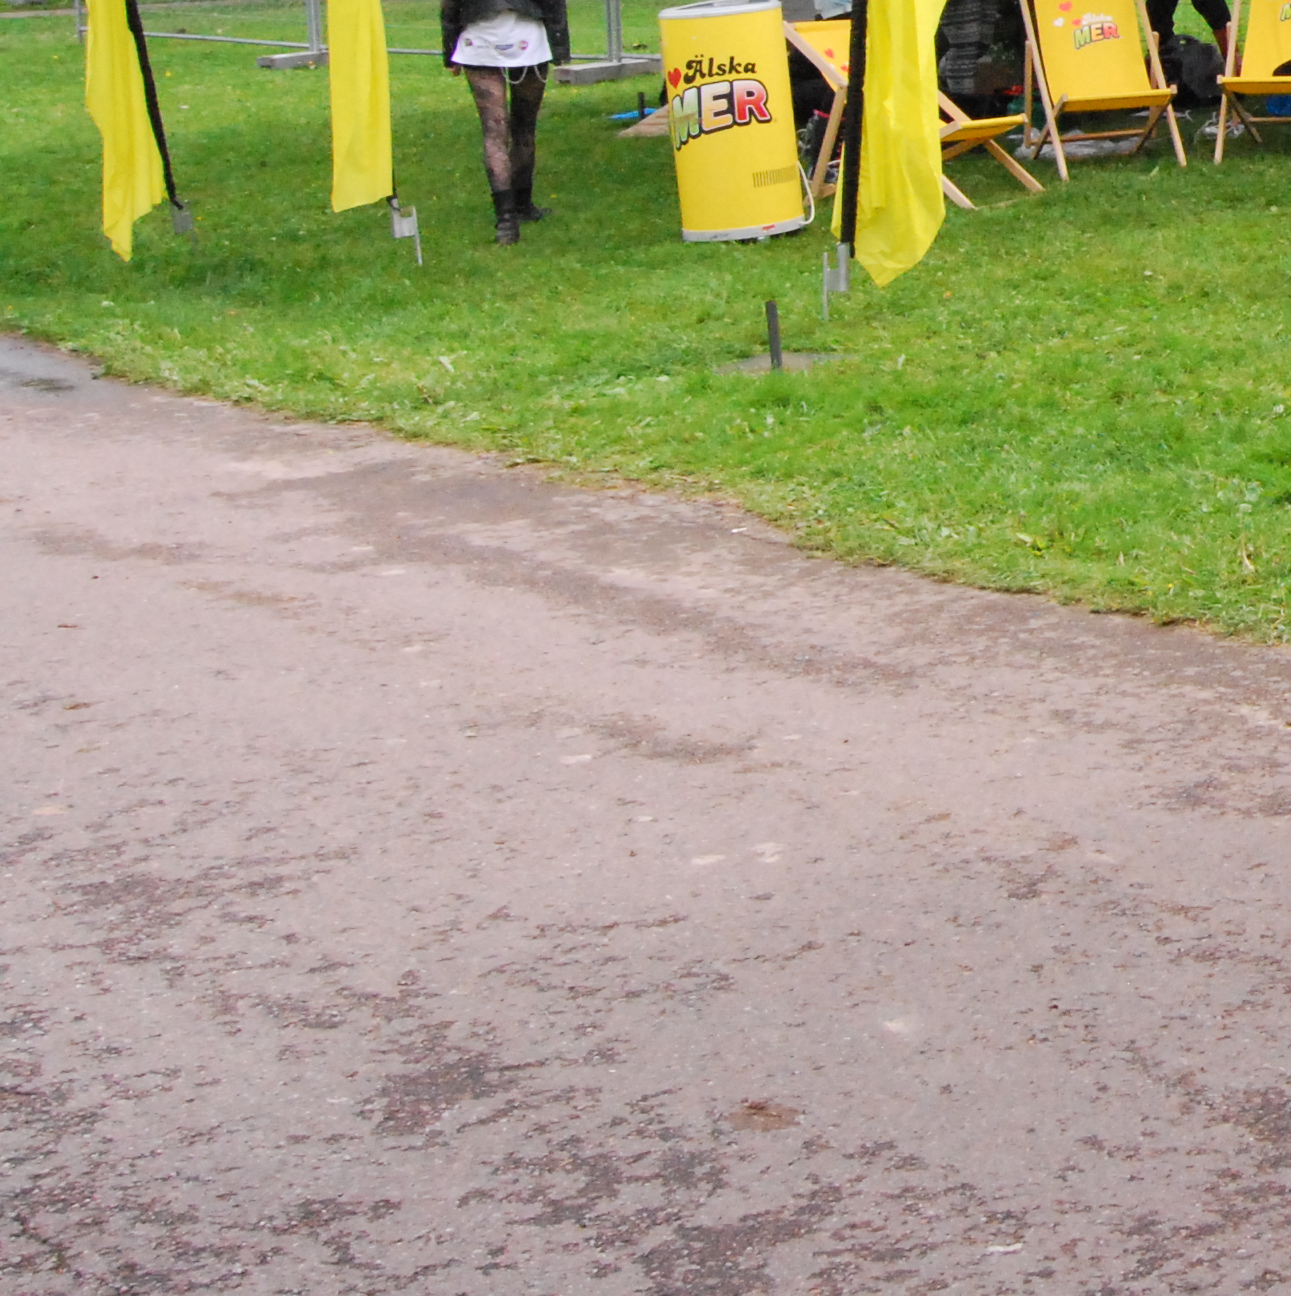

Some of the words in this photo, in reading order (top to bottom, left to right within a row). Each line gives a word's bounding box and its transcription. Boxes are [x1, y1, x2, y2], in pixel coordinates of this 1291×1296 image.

[1073, 22, 1120, 49] MER
[683, 54, 757, 84] Älska
[671, 78, 772, 151] MER
